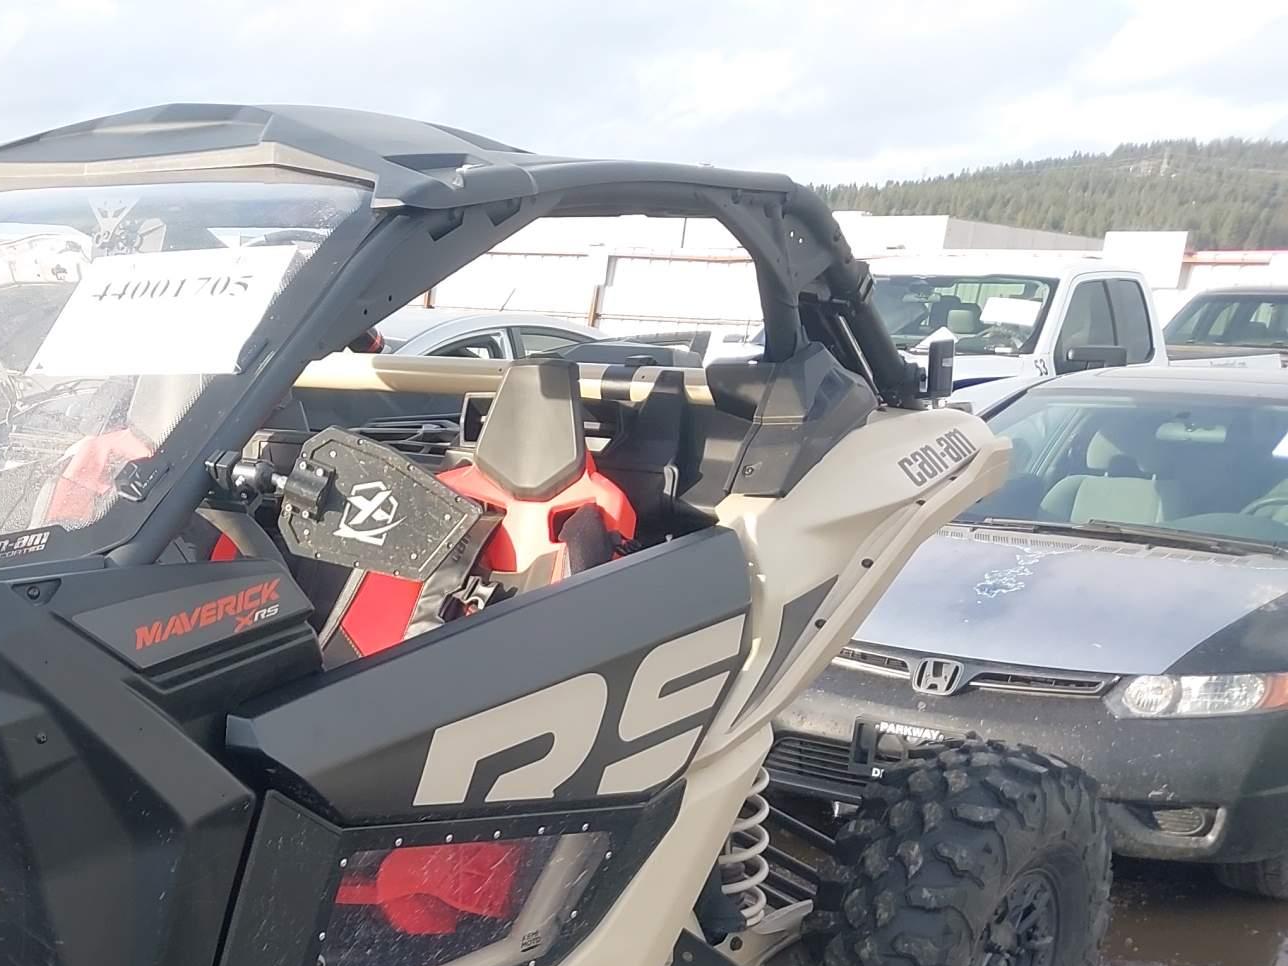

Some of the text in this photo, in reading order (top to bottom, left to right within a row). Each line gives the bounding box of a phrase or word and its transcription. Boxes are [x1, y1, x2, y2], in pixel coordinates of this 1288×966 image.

[897, 427, 977, 487] can-am
[135, 578, 281, 650] MAVERICK
[412, 613, 747, 807] RS
[879, 721, 941, 740] PARKWAY
